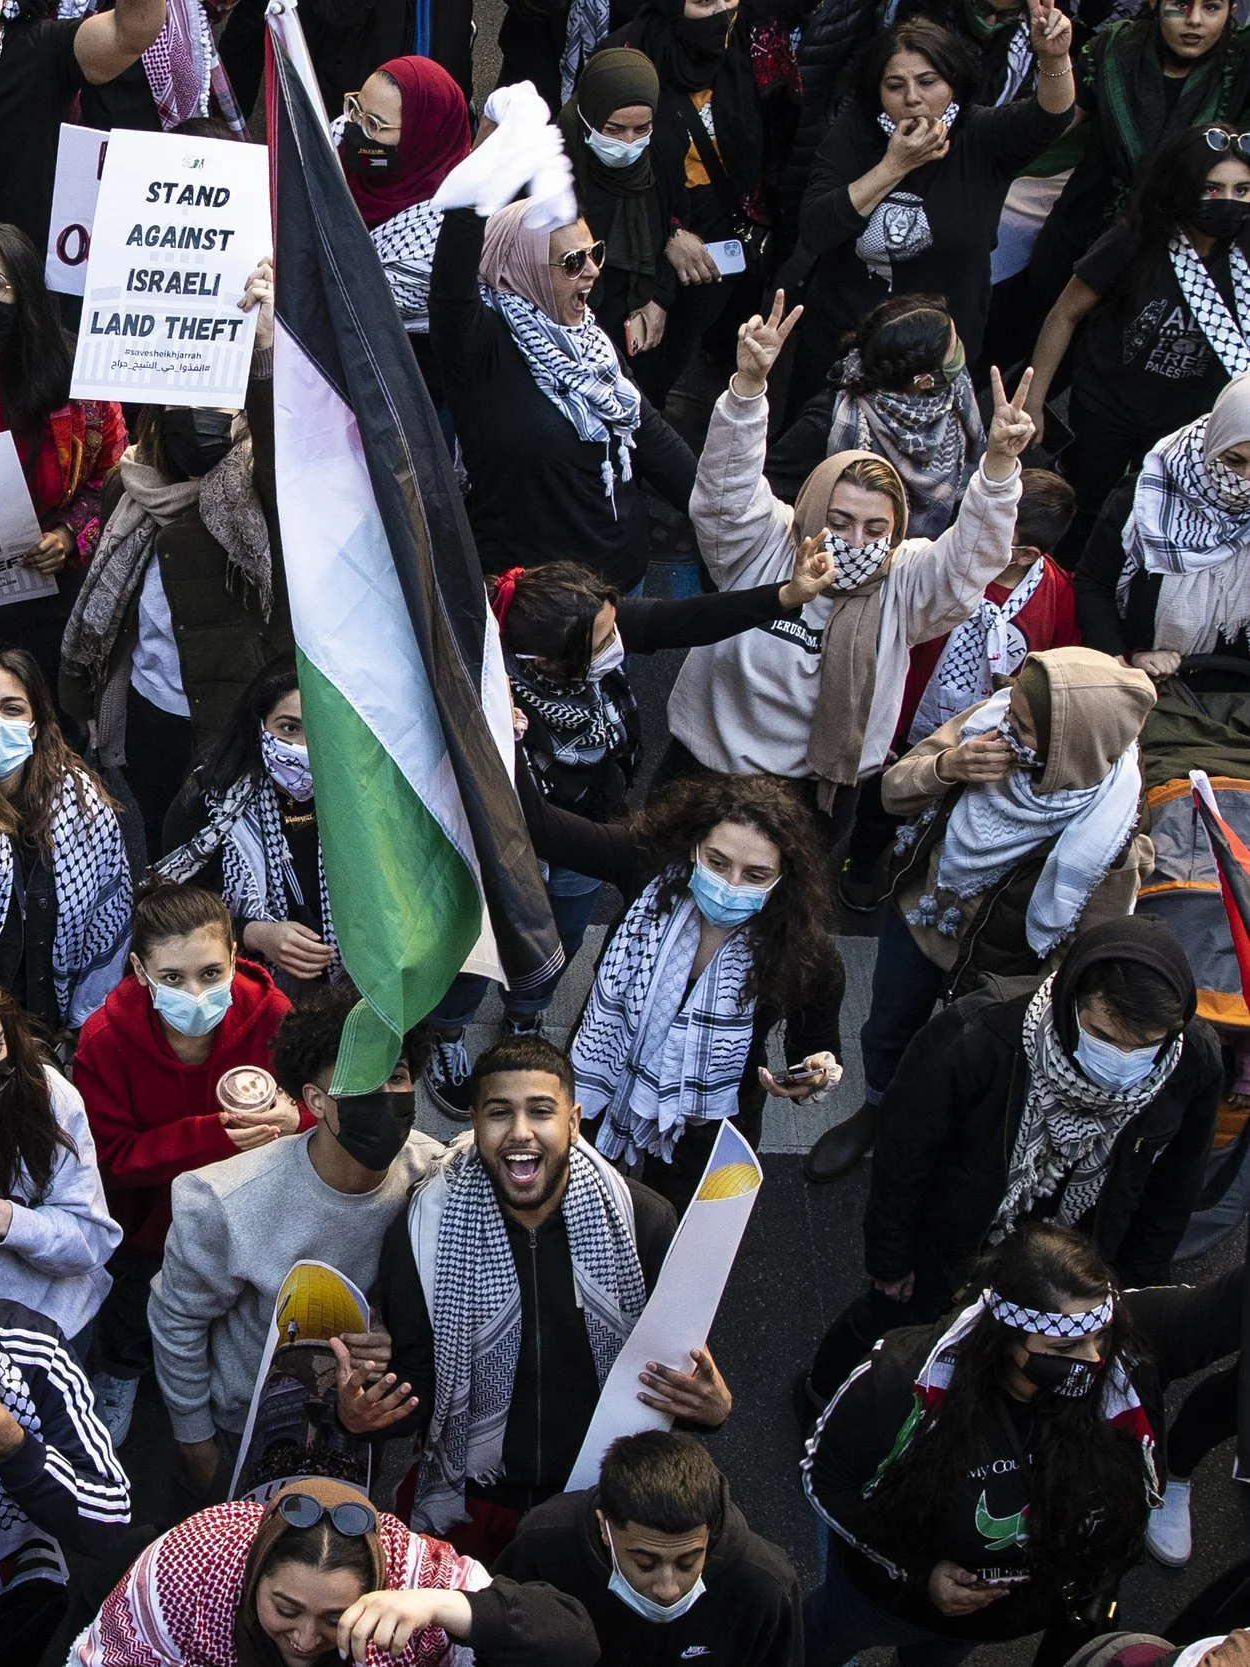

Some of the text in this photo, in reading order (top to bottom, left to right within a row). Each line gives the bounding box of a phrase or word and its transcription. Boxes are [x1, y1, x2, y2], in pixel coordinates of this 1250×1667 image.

[146, 181, 230, 208] STAND
[126, 224, 235, 251] AGAINST
[126, 268, 221, 297] ISRAELI
[90, 311, 243, 342] LAND THEFT
[124, 348, 202, 360] #savesheikhjarrah
[771, 620, 818, 649] JERUSAM,
